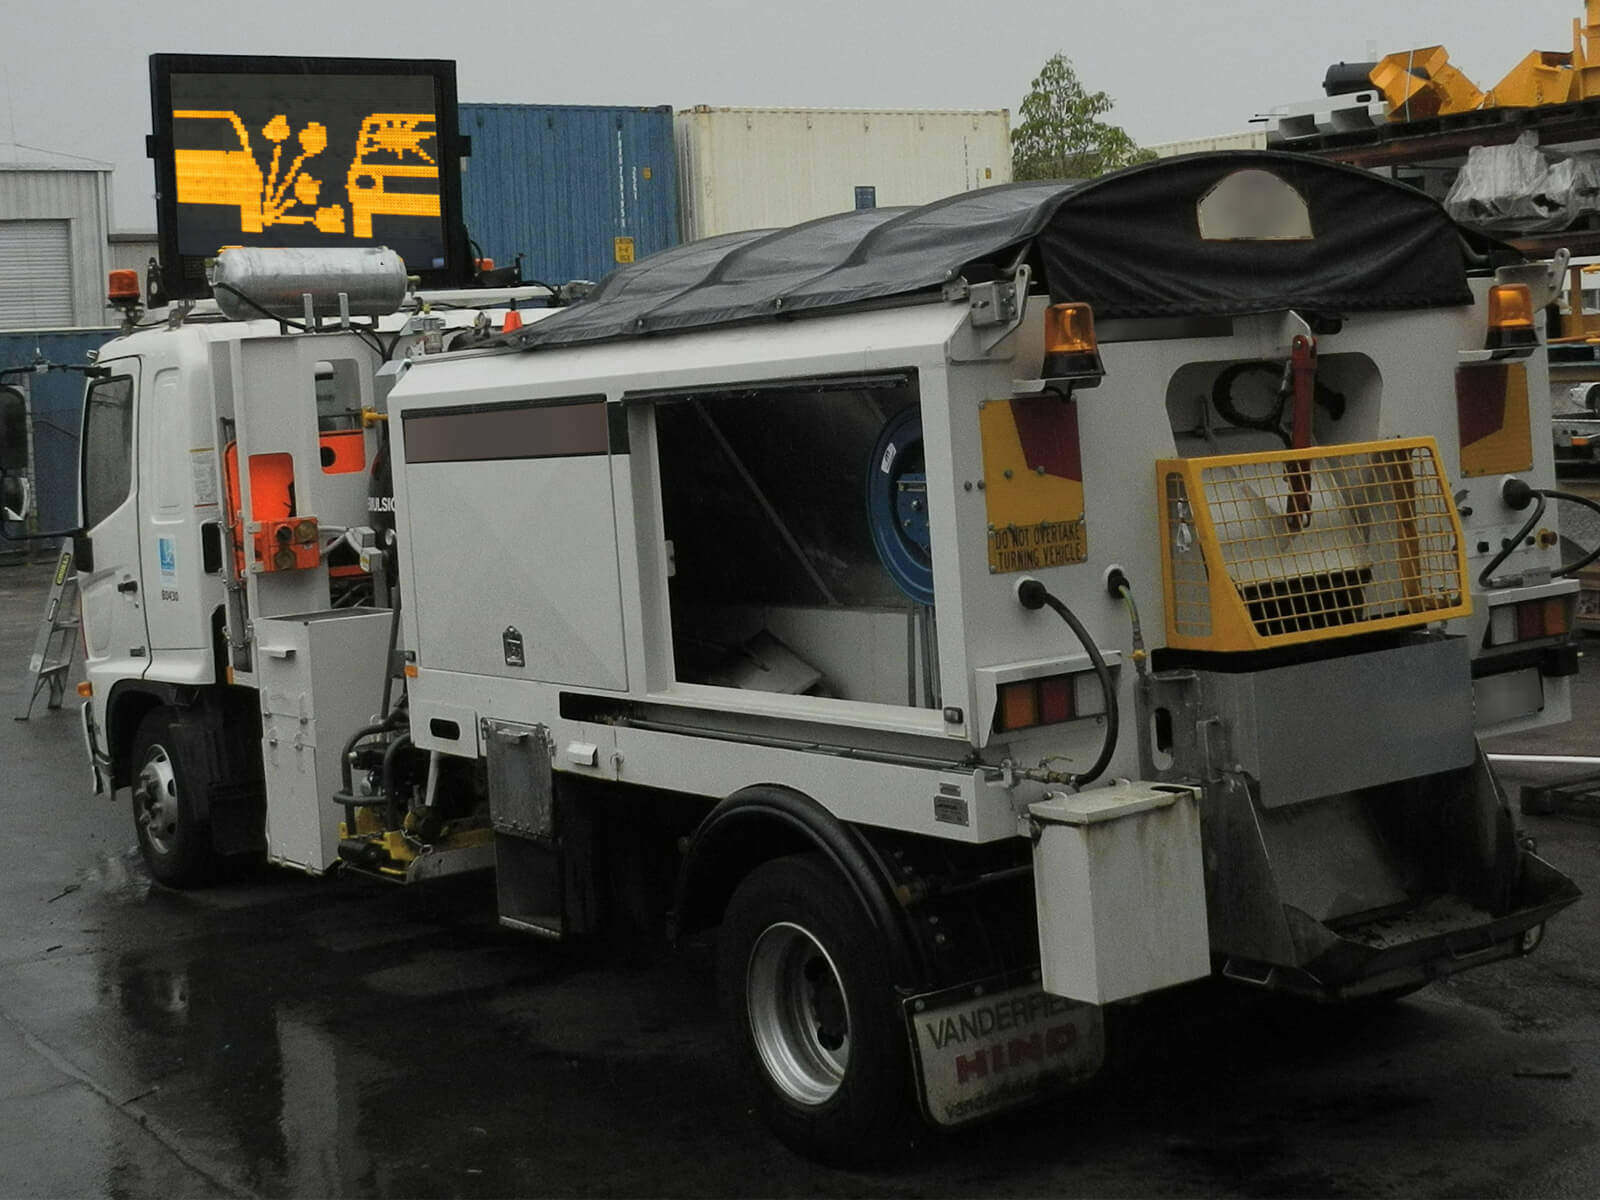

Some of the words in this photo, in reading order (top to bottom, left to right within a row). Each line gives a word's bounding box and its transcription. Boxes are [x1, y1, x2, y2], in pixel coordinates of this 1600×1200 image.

[995, 530, 1009, 550] DO
[1011, 526, 1029, 548] NOT
[1033, 522, 1081, 546] OVERTAKE
[998, 547, 1040, 569] TURNING
[1043, 542, 1081, 566] VEHICLE
[926, 993, 1087, 1050] VANDERFIEL
[956, 1022, 1077, 1085] HINO
